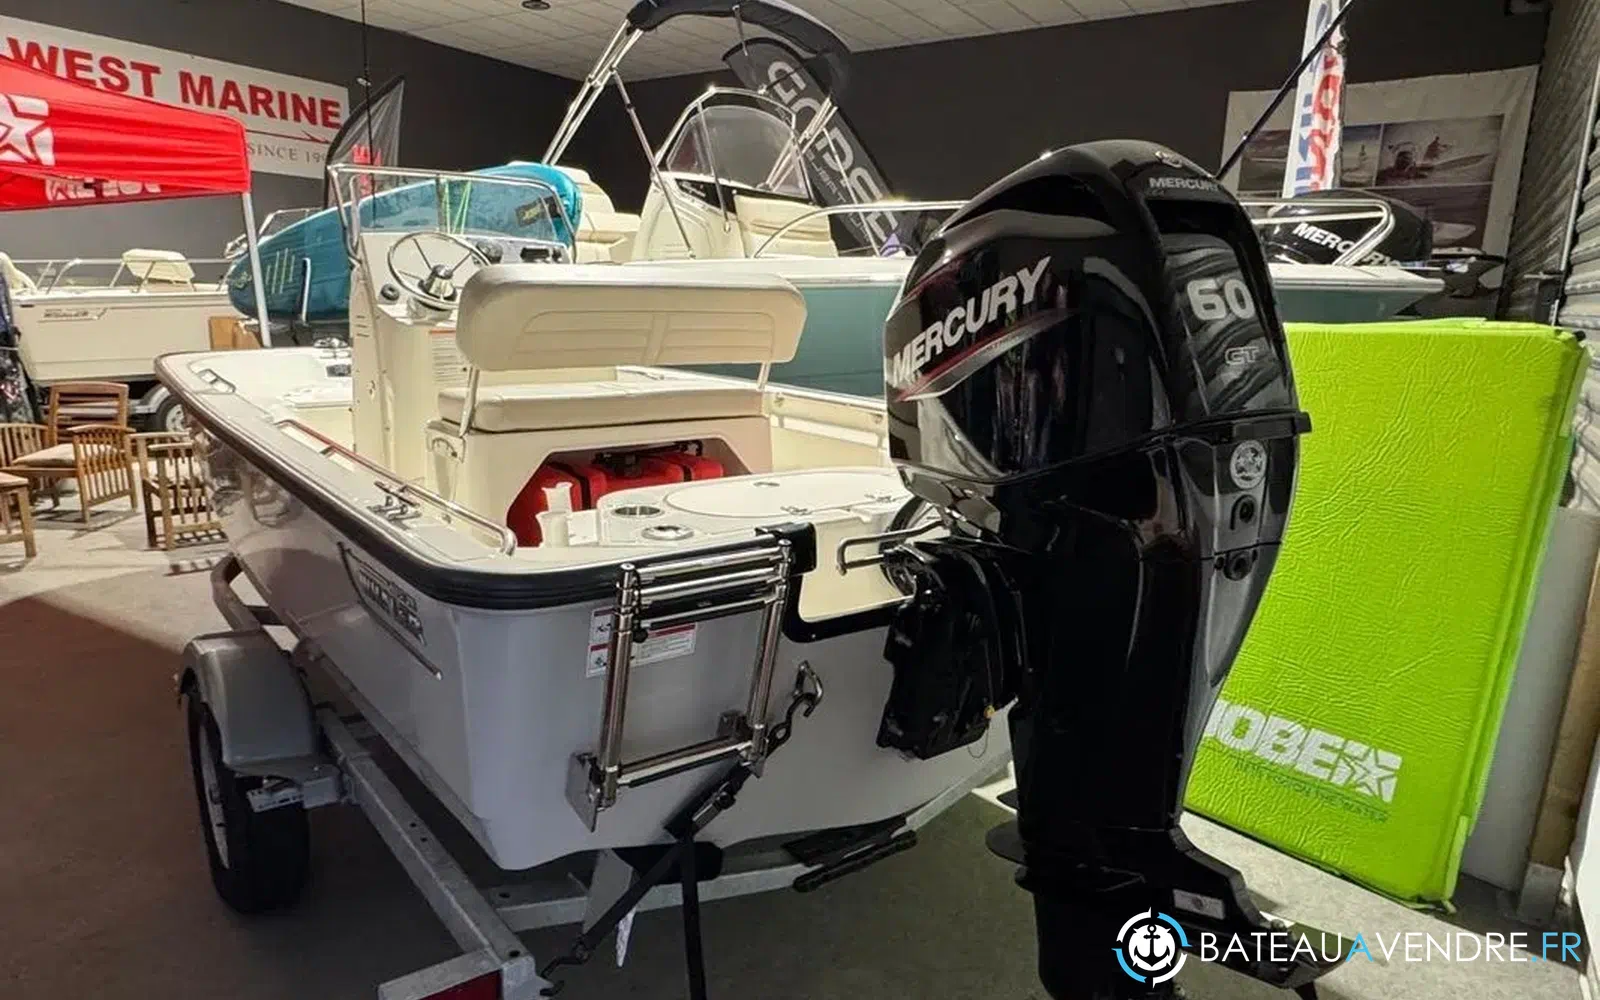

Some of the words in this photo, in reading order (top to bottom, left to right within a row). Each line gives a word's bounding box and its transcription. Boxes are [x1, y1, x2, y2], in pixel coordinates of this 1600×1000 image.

[7, 37, 161, 98] WEST
[178, 71, 342, 130] MARINE
[248, 143, 298, 161] SINCE
[1292, 221, 1401, 268] MERCRY
[1187, 279, 1255, 320] 60
[893, 256, 1052, 388] MERCURY
[1225, 346, 1260, 365] GT
